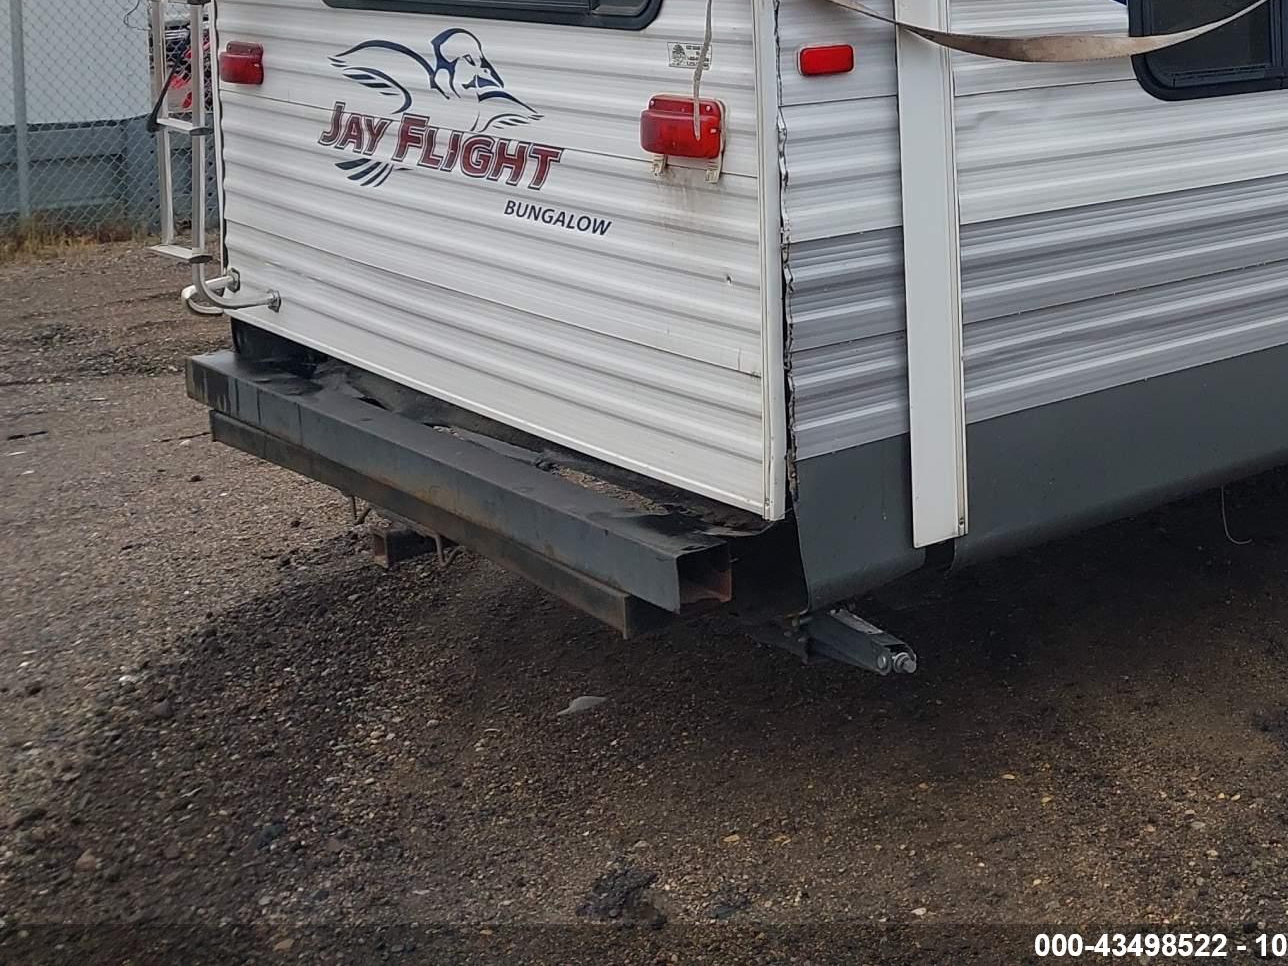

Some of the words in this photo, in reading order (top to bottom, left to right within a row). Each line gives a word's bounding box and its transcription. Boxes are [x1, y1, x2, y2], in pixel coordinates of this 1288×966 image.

[317, 101, 392, 156] JAY
[391, 112, 566, 191] FLIGHT
[504, 200, 612, 236] BUNGALOW
